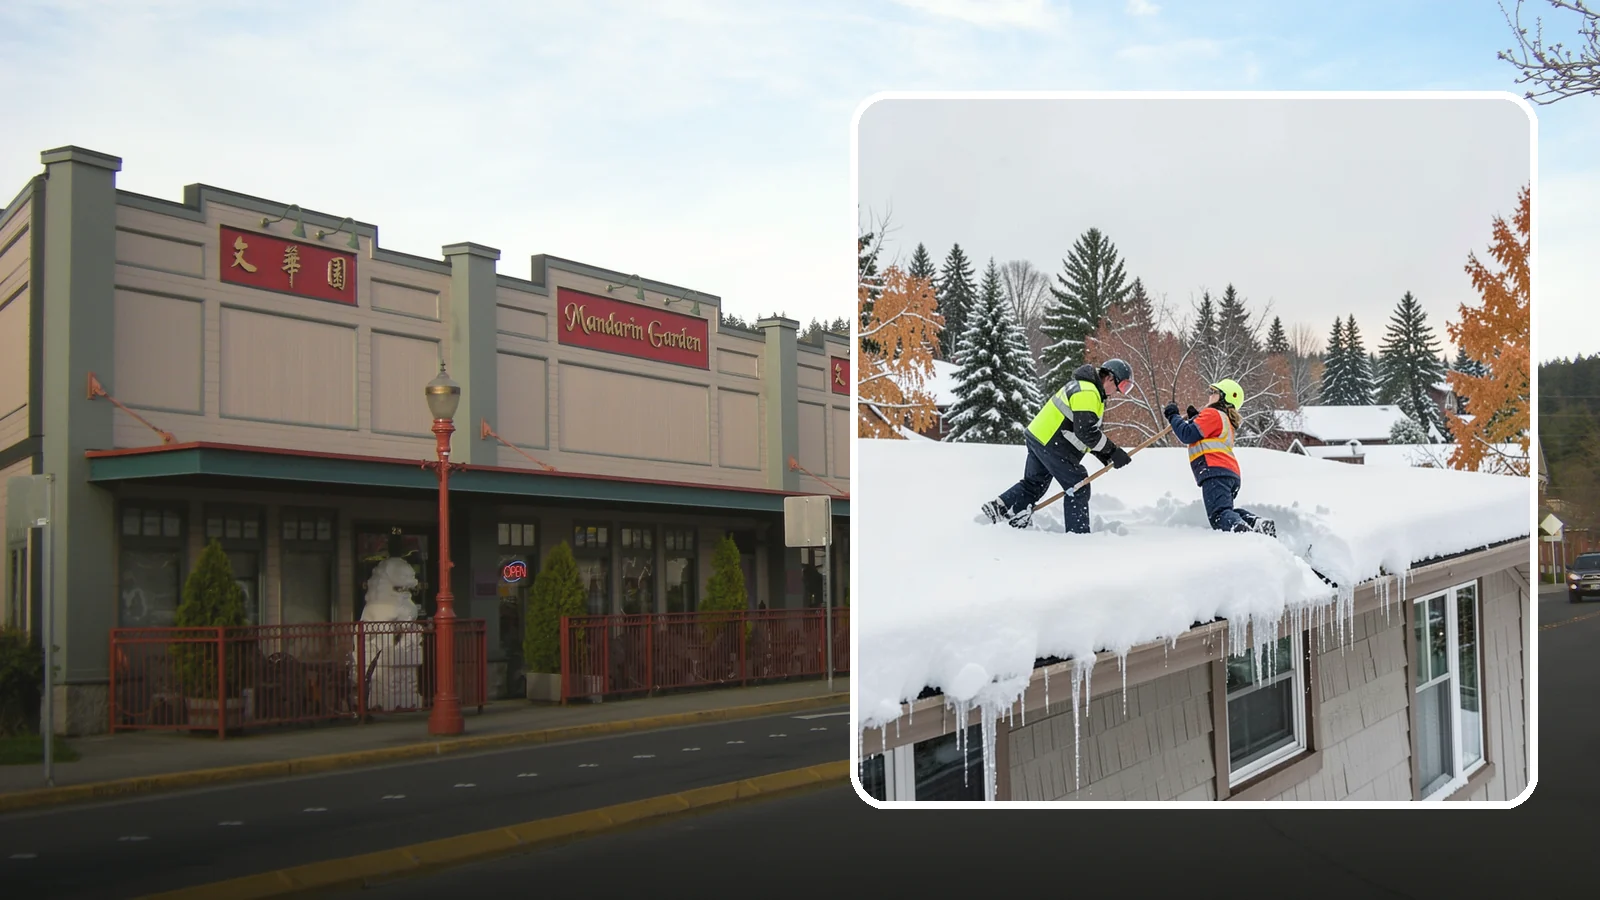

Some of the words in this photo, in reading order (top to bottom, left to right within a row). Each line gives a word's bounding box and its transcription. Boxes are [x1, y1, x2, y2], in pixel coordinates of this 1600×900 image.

[230, 235, 346, 291] 文華園
[564, 302, 644, 340] Mandarin
[648, 320, 702, 352] Garden
[503, 565, 527, 578] OPEN
